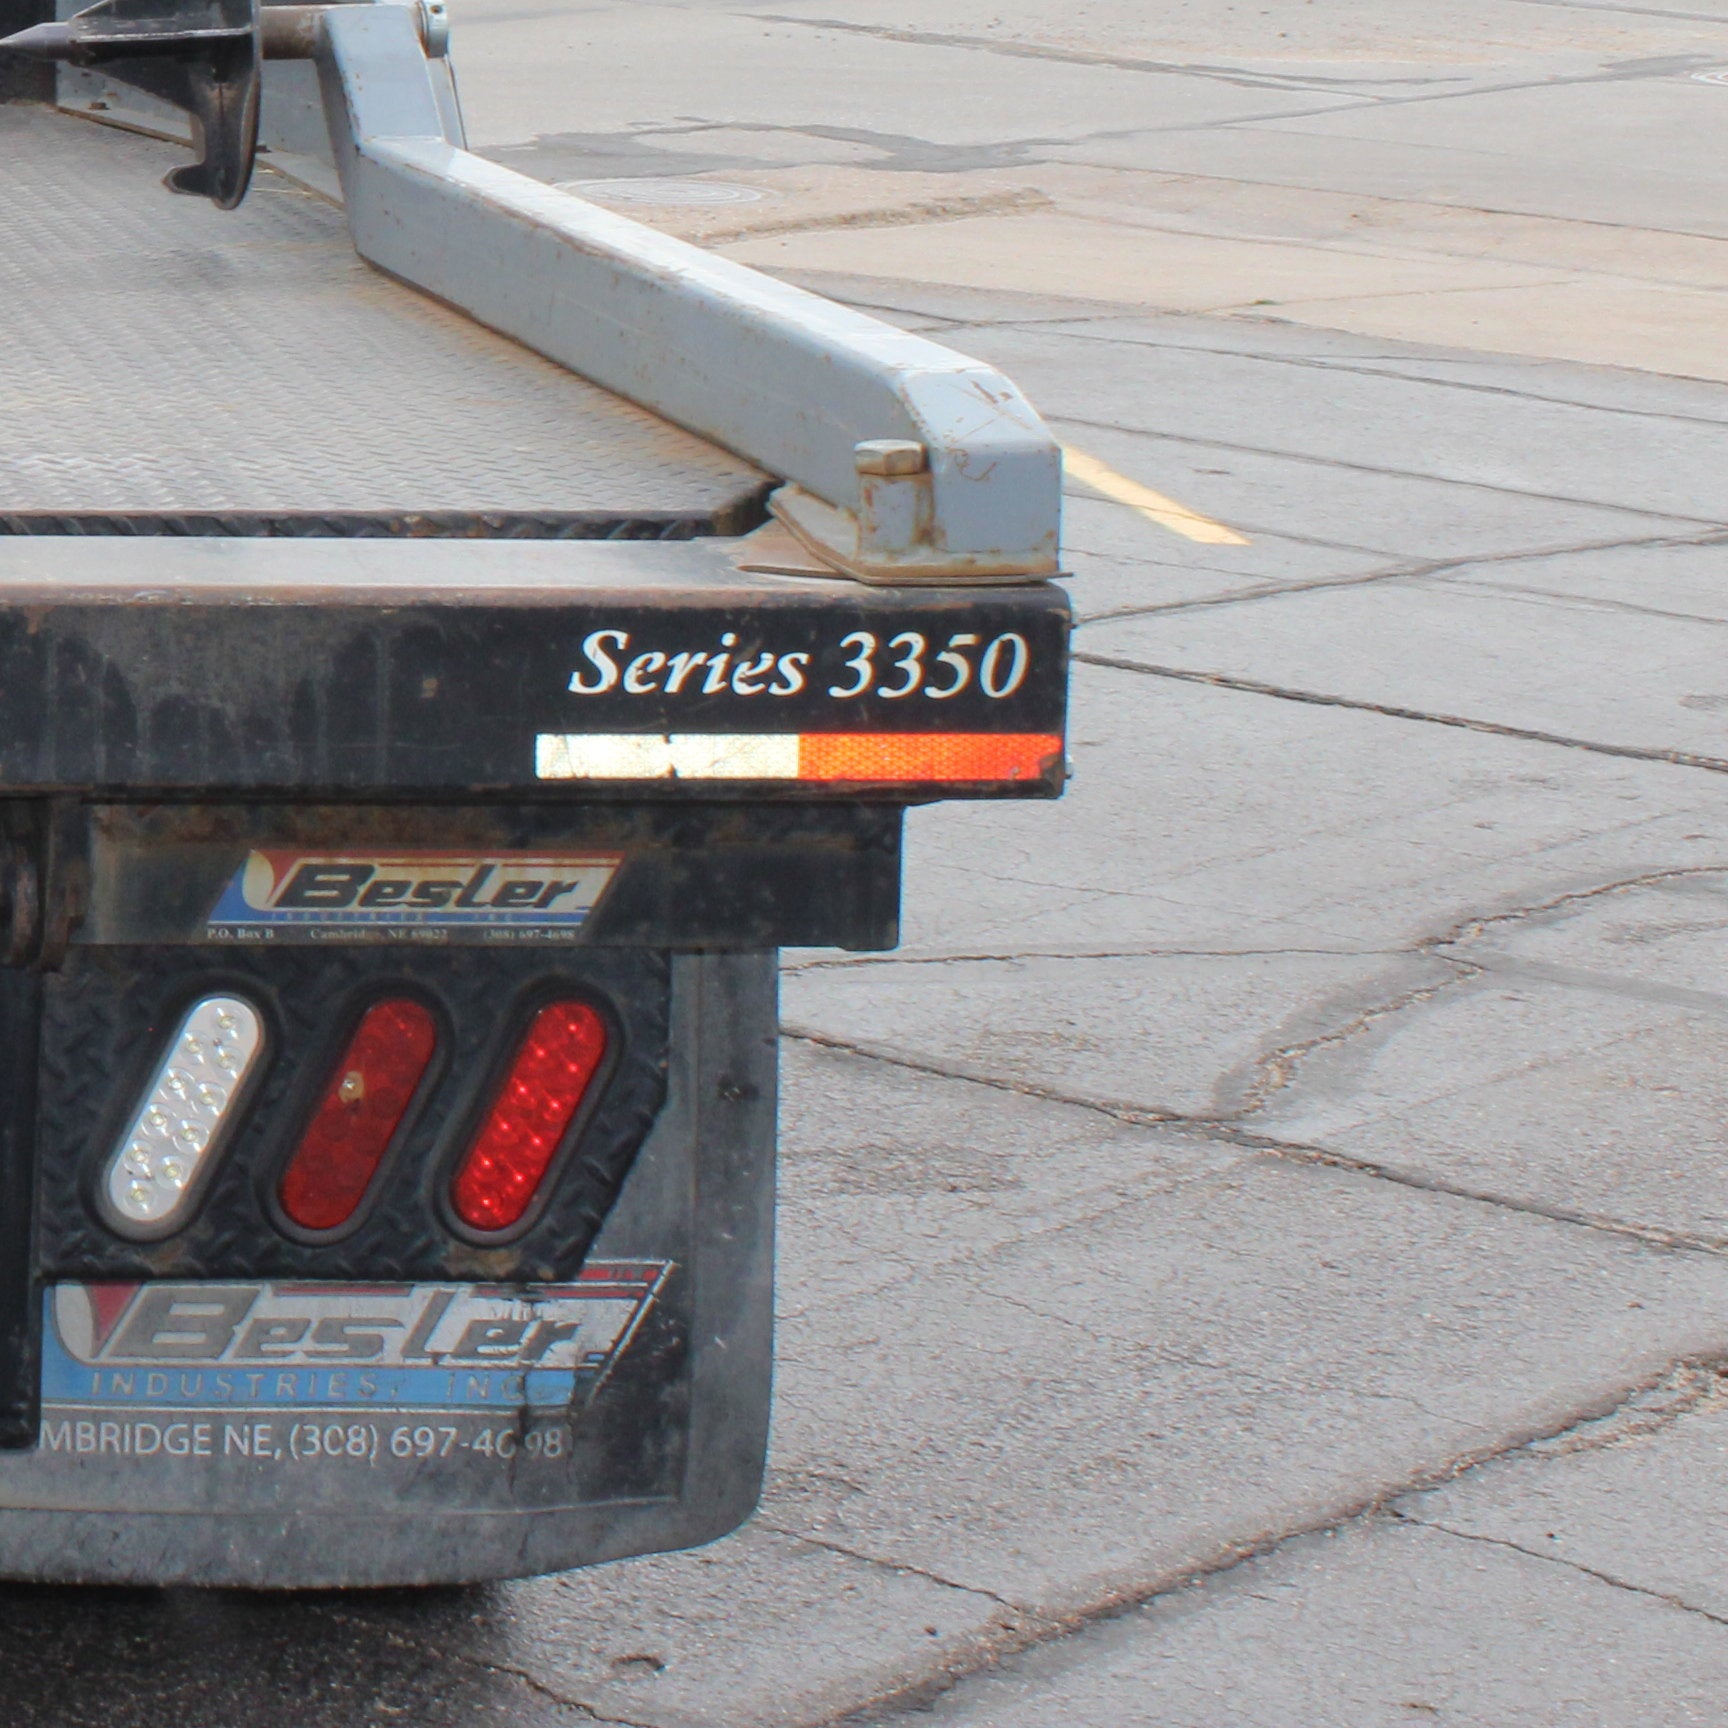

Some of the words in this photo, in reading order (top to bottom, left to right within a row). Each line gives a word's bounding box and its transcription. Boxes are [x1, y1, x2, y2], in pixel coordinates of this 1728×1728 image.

[568, 629, 811, 696] Series
[828, 631, 1030, 699] 3350
[273, 863, 580, 908] Besler
[106, 1287, 582, 1359] Besler
[223, 1423, 283, 1461] NE,
[290, 1423, 378, 1468] (308)
